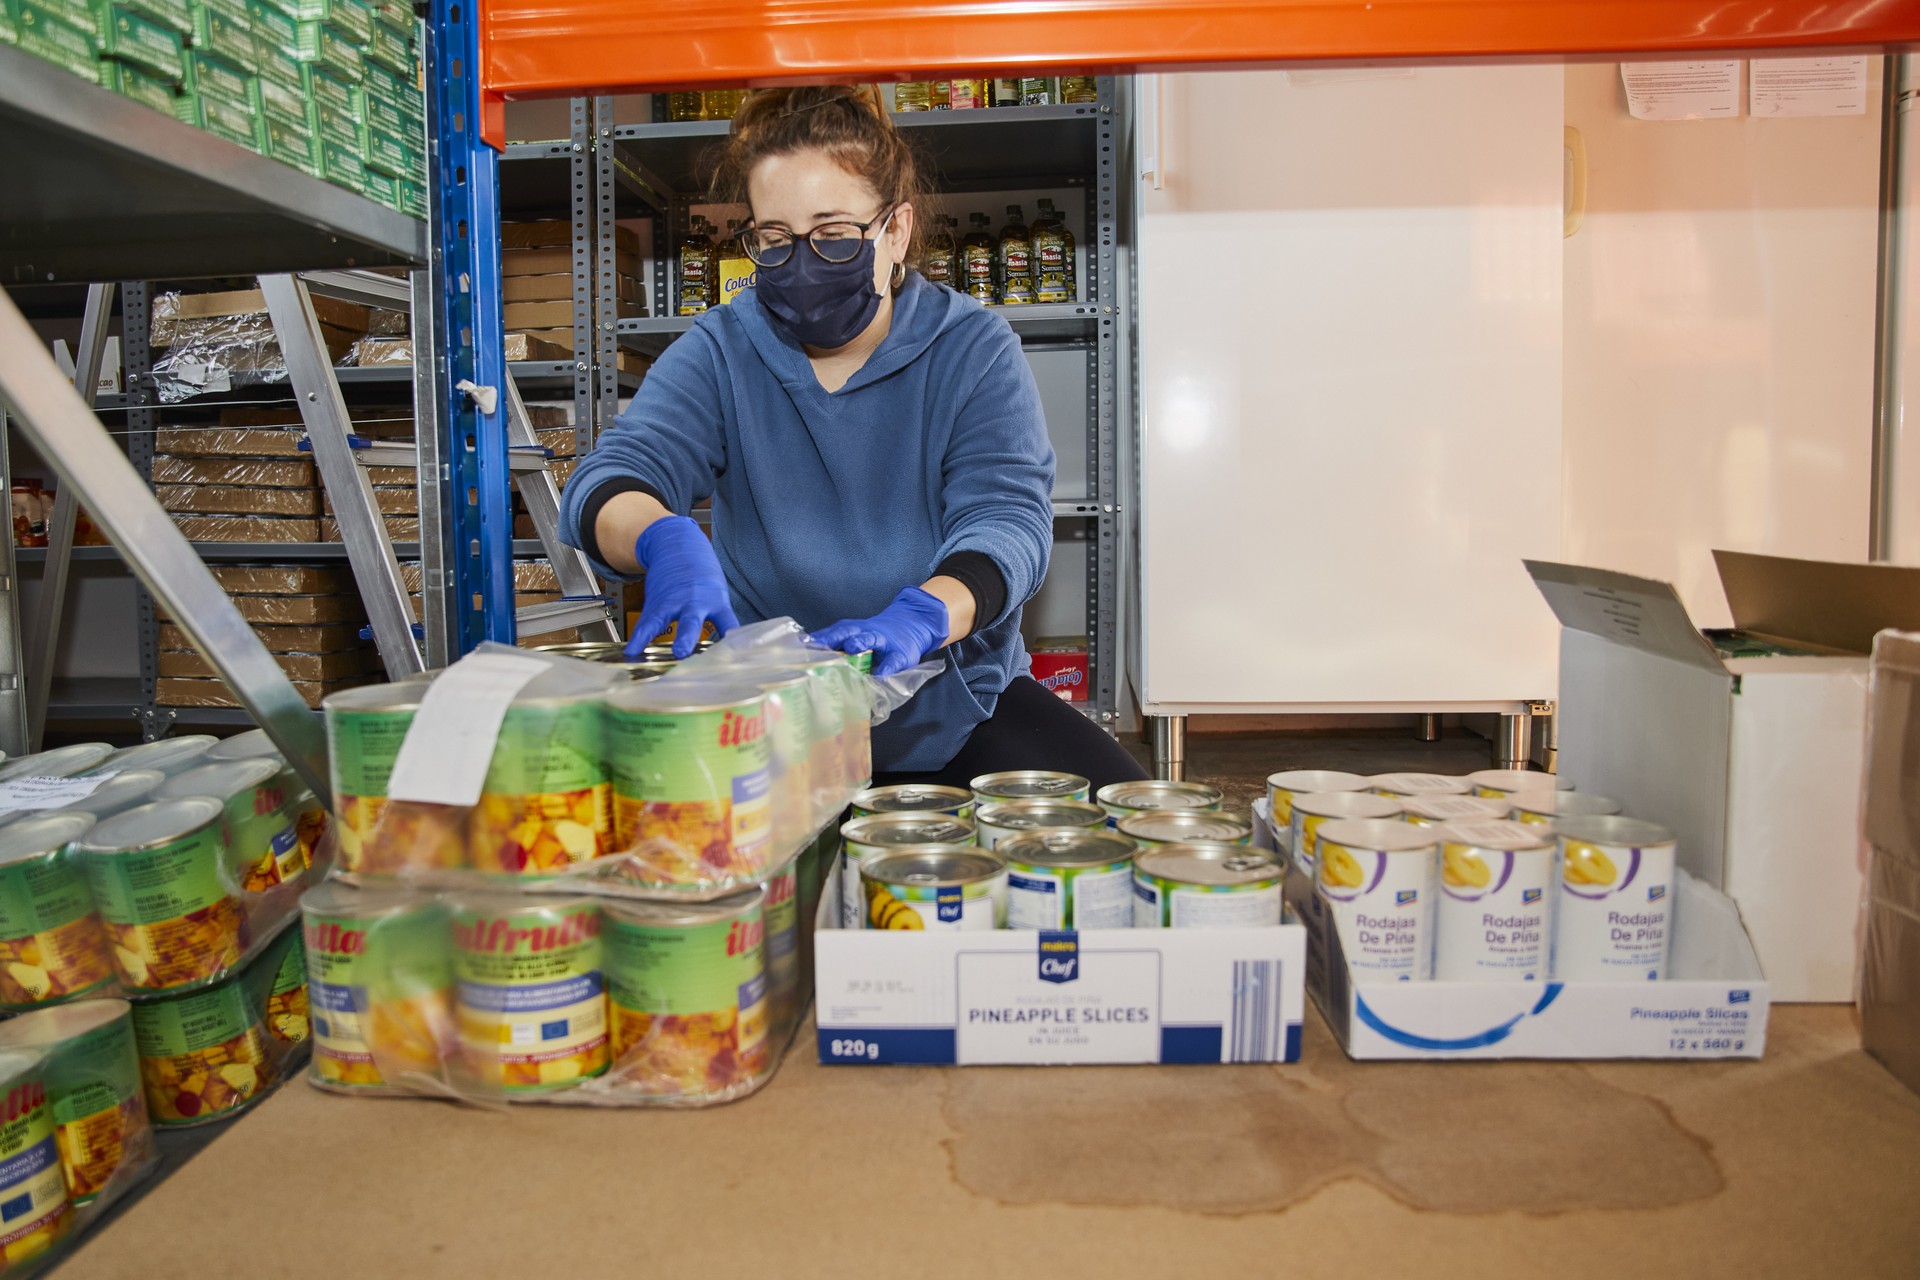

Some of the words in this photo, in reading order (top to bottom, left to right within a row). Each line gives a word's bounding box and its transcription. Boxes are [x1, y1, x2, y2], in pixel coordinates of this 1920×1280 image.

[1357, 914, 1416, 931] Rodajas
[1482, 913, 1540, 930] Rodajas
[1608, 911, 1664, 926] Rodajas
[1360, 931, 1379, 943] De
[1385, 932, 1415, 944] Piña
[1485, 930, 1506, 943] De
[1512, 930, 1539, 943] Piña
[1611, 928, 1631, 940] De
[1636, 928, 1662, 940] Piña
[1041, 941, 1077, 952] makro
[1041, 958, 1077, 979] Chef
[969, 1007, 1077, 1024] PINEAPPLE
[1082, 1007, 1150, 1024] SLICES
[1630, 1007, 1700, 1020] Pineapple
[1705, 1007, 1748, 1019] Slices
[1669, 1039, 1685, 1049] 12
[1690, 1041, 1698, 1049] x
[1734, 1041, 1744, 1050] g
